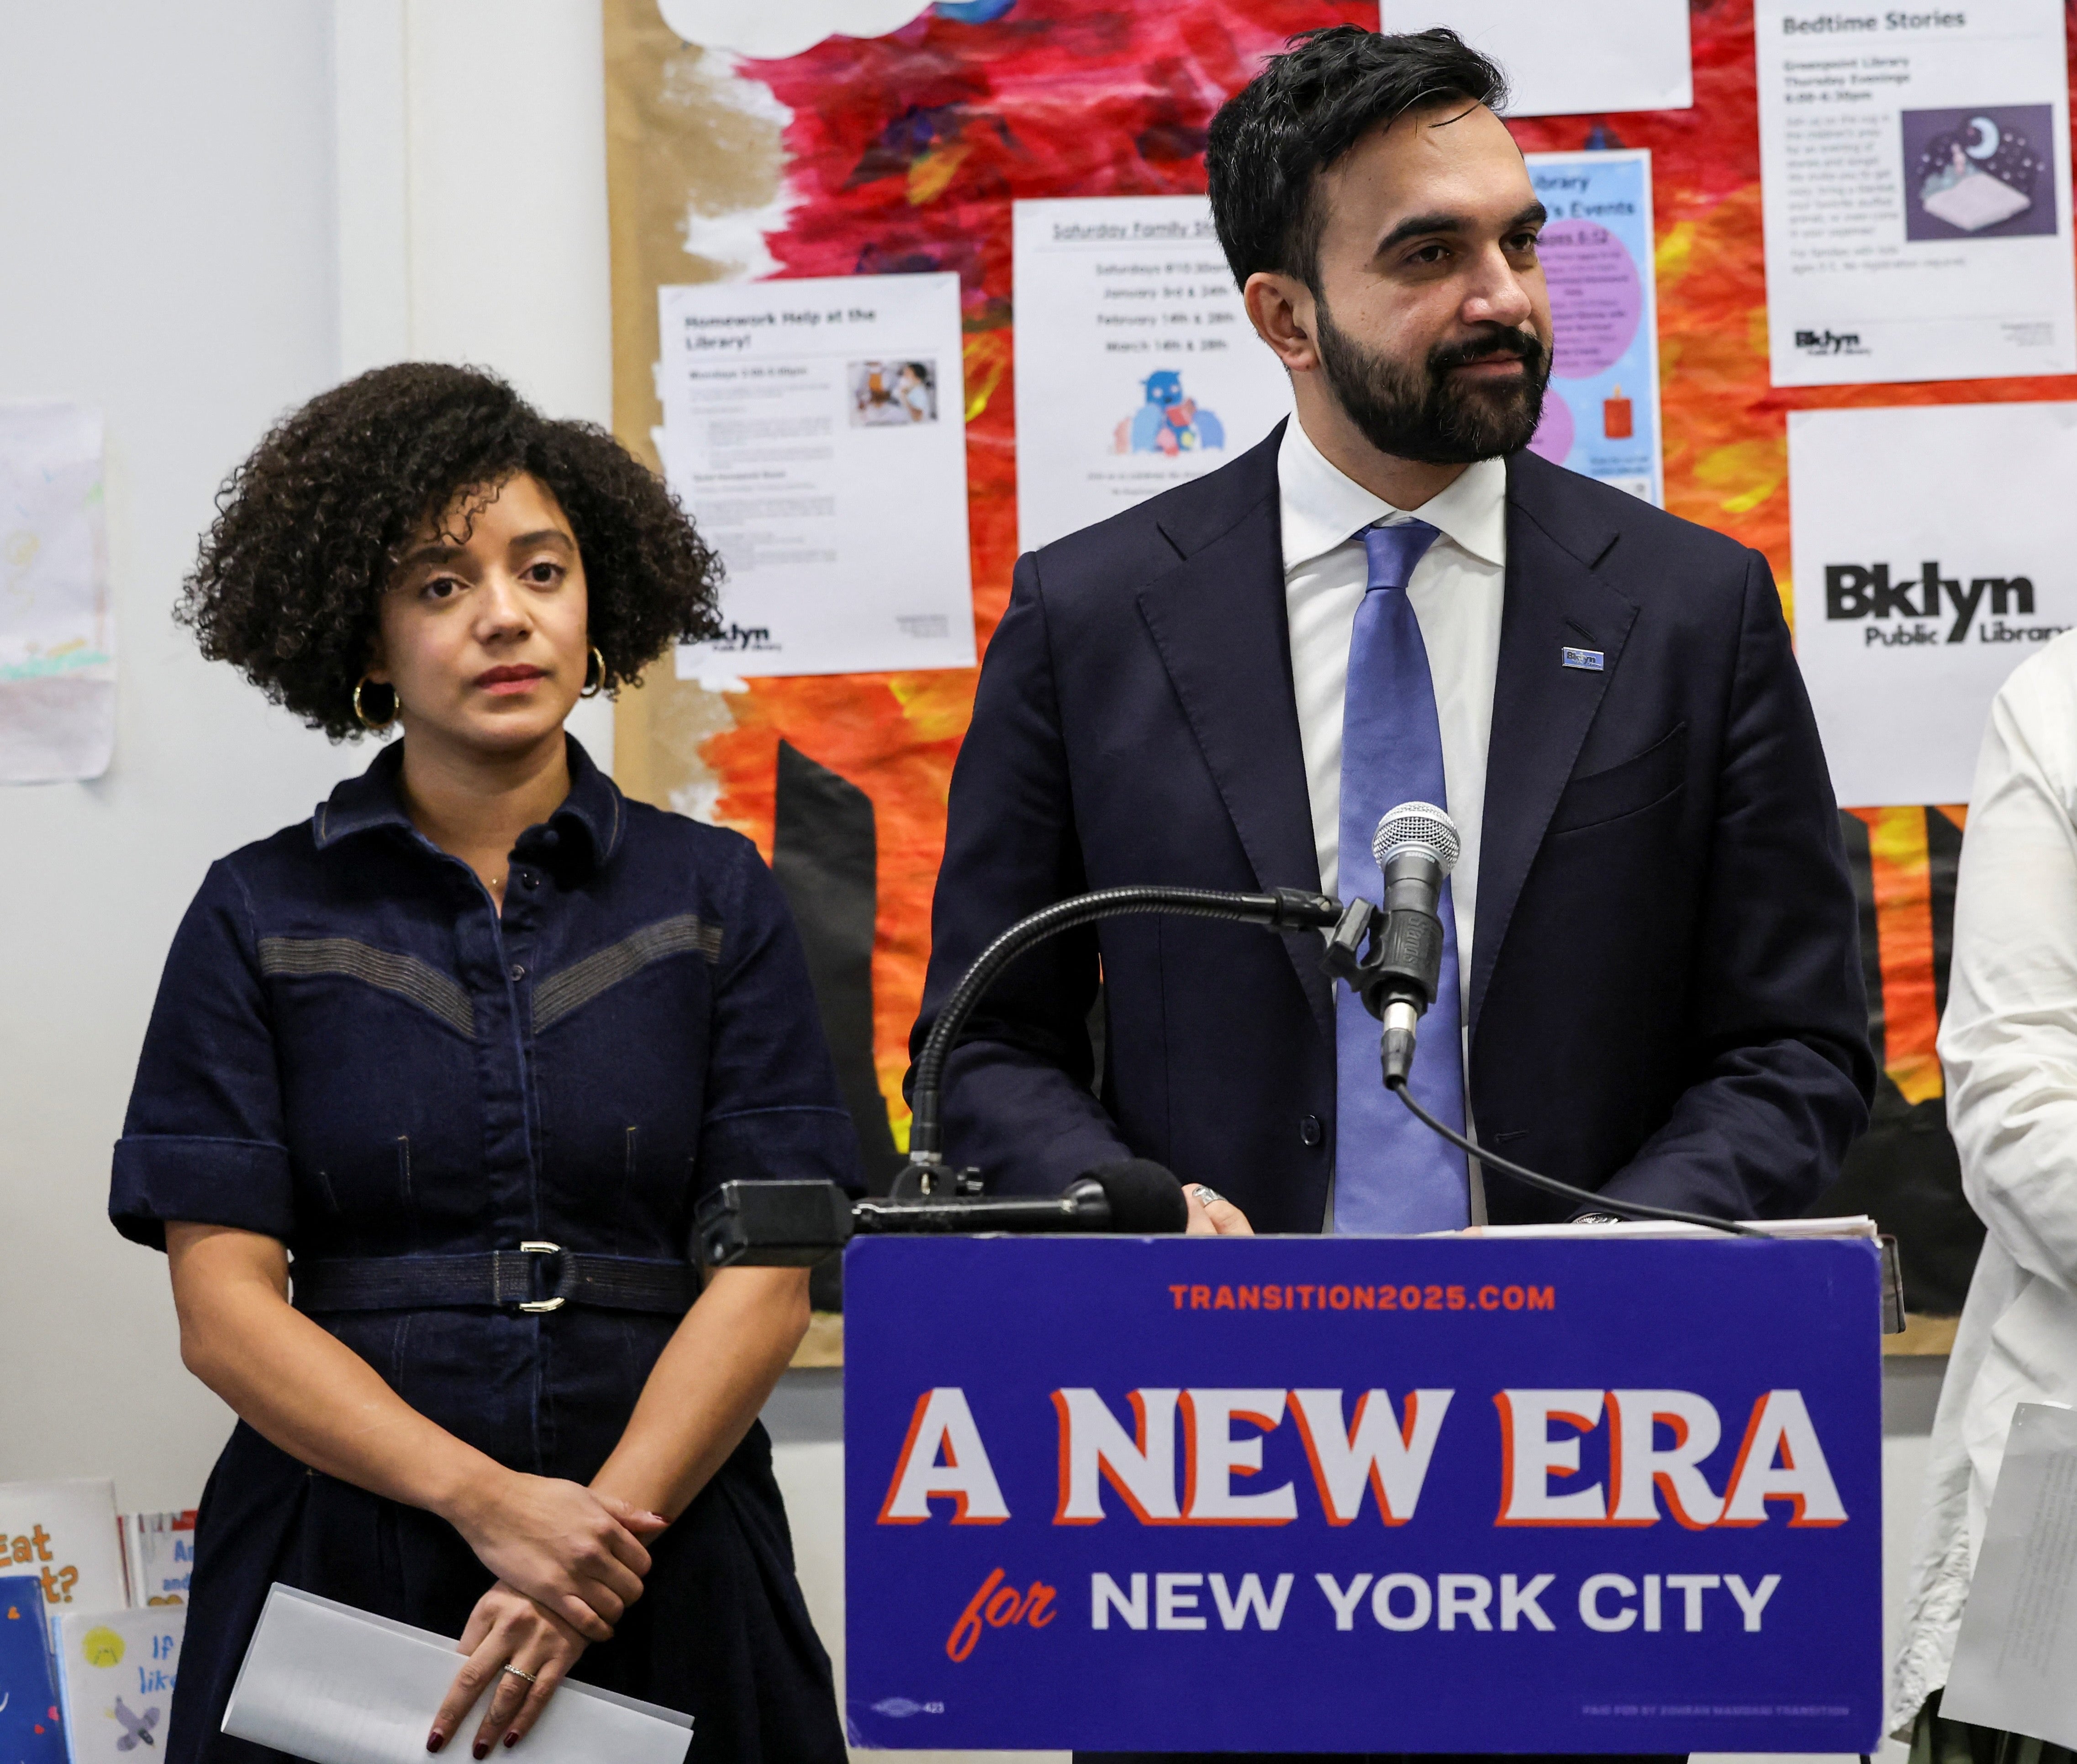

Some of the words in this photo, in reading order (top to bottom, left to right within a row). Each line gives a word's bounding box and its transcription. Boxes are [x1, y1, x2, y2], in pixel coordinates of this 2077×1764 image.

[1782, 15, 1878, 35] Bedtime
[1886, 9, 1966, 30] Stories
[1861, 58, 1909, 68] Library
[1570, 201, 1635, 218] Events
[1053, 222, 1128, 239] Saturday
[1132, 221, 1188, 238] Family
[685, 312, 775, 329] Homework
[782, 310, 821, 327] Help
[827, 309, 842, 323] at
[848, 307, 876, 323] the
[1825, 562, 2035, 644] Bklyn
[1865, 621, 1938, 647] Public
[1169, 1285, 1555, 1310] TRANSITION2025.COM
[876, 1387, 1011, 1526] A
[1049, 1387, 1455, 1527] NEW
[1492, 1389, 1849, 1531] ERA
[946, 1567, 1057, 1663] for
[1091, 1572, 1295, 1631] NEW
[1315, 1573, 1556, 1632] YORK
[1578, 1573, 1781, 1632] CITY
[153, 1635, 174, 1660] If
